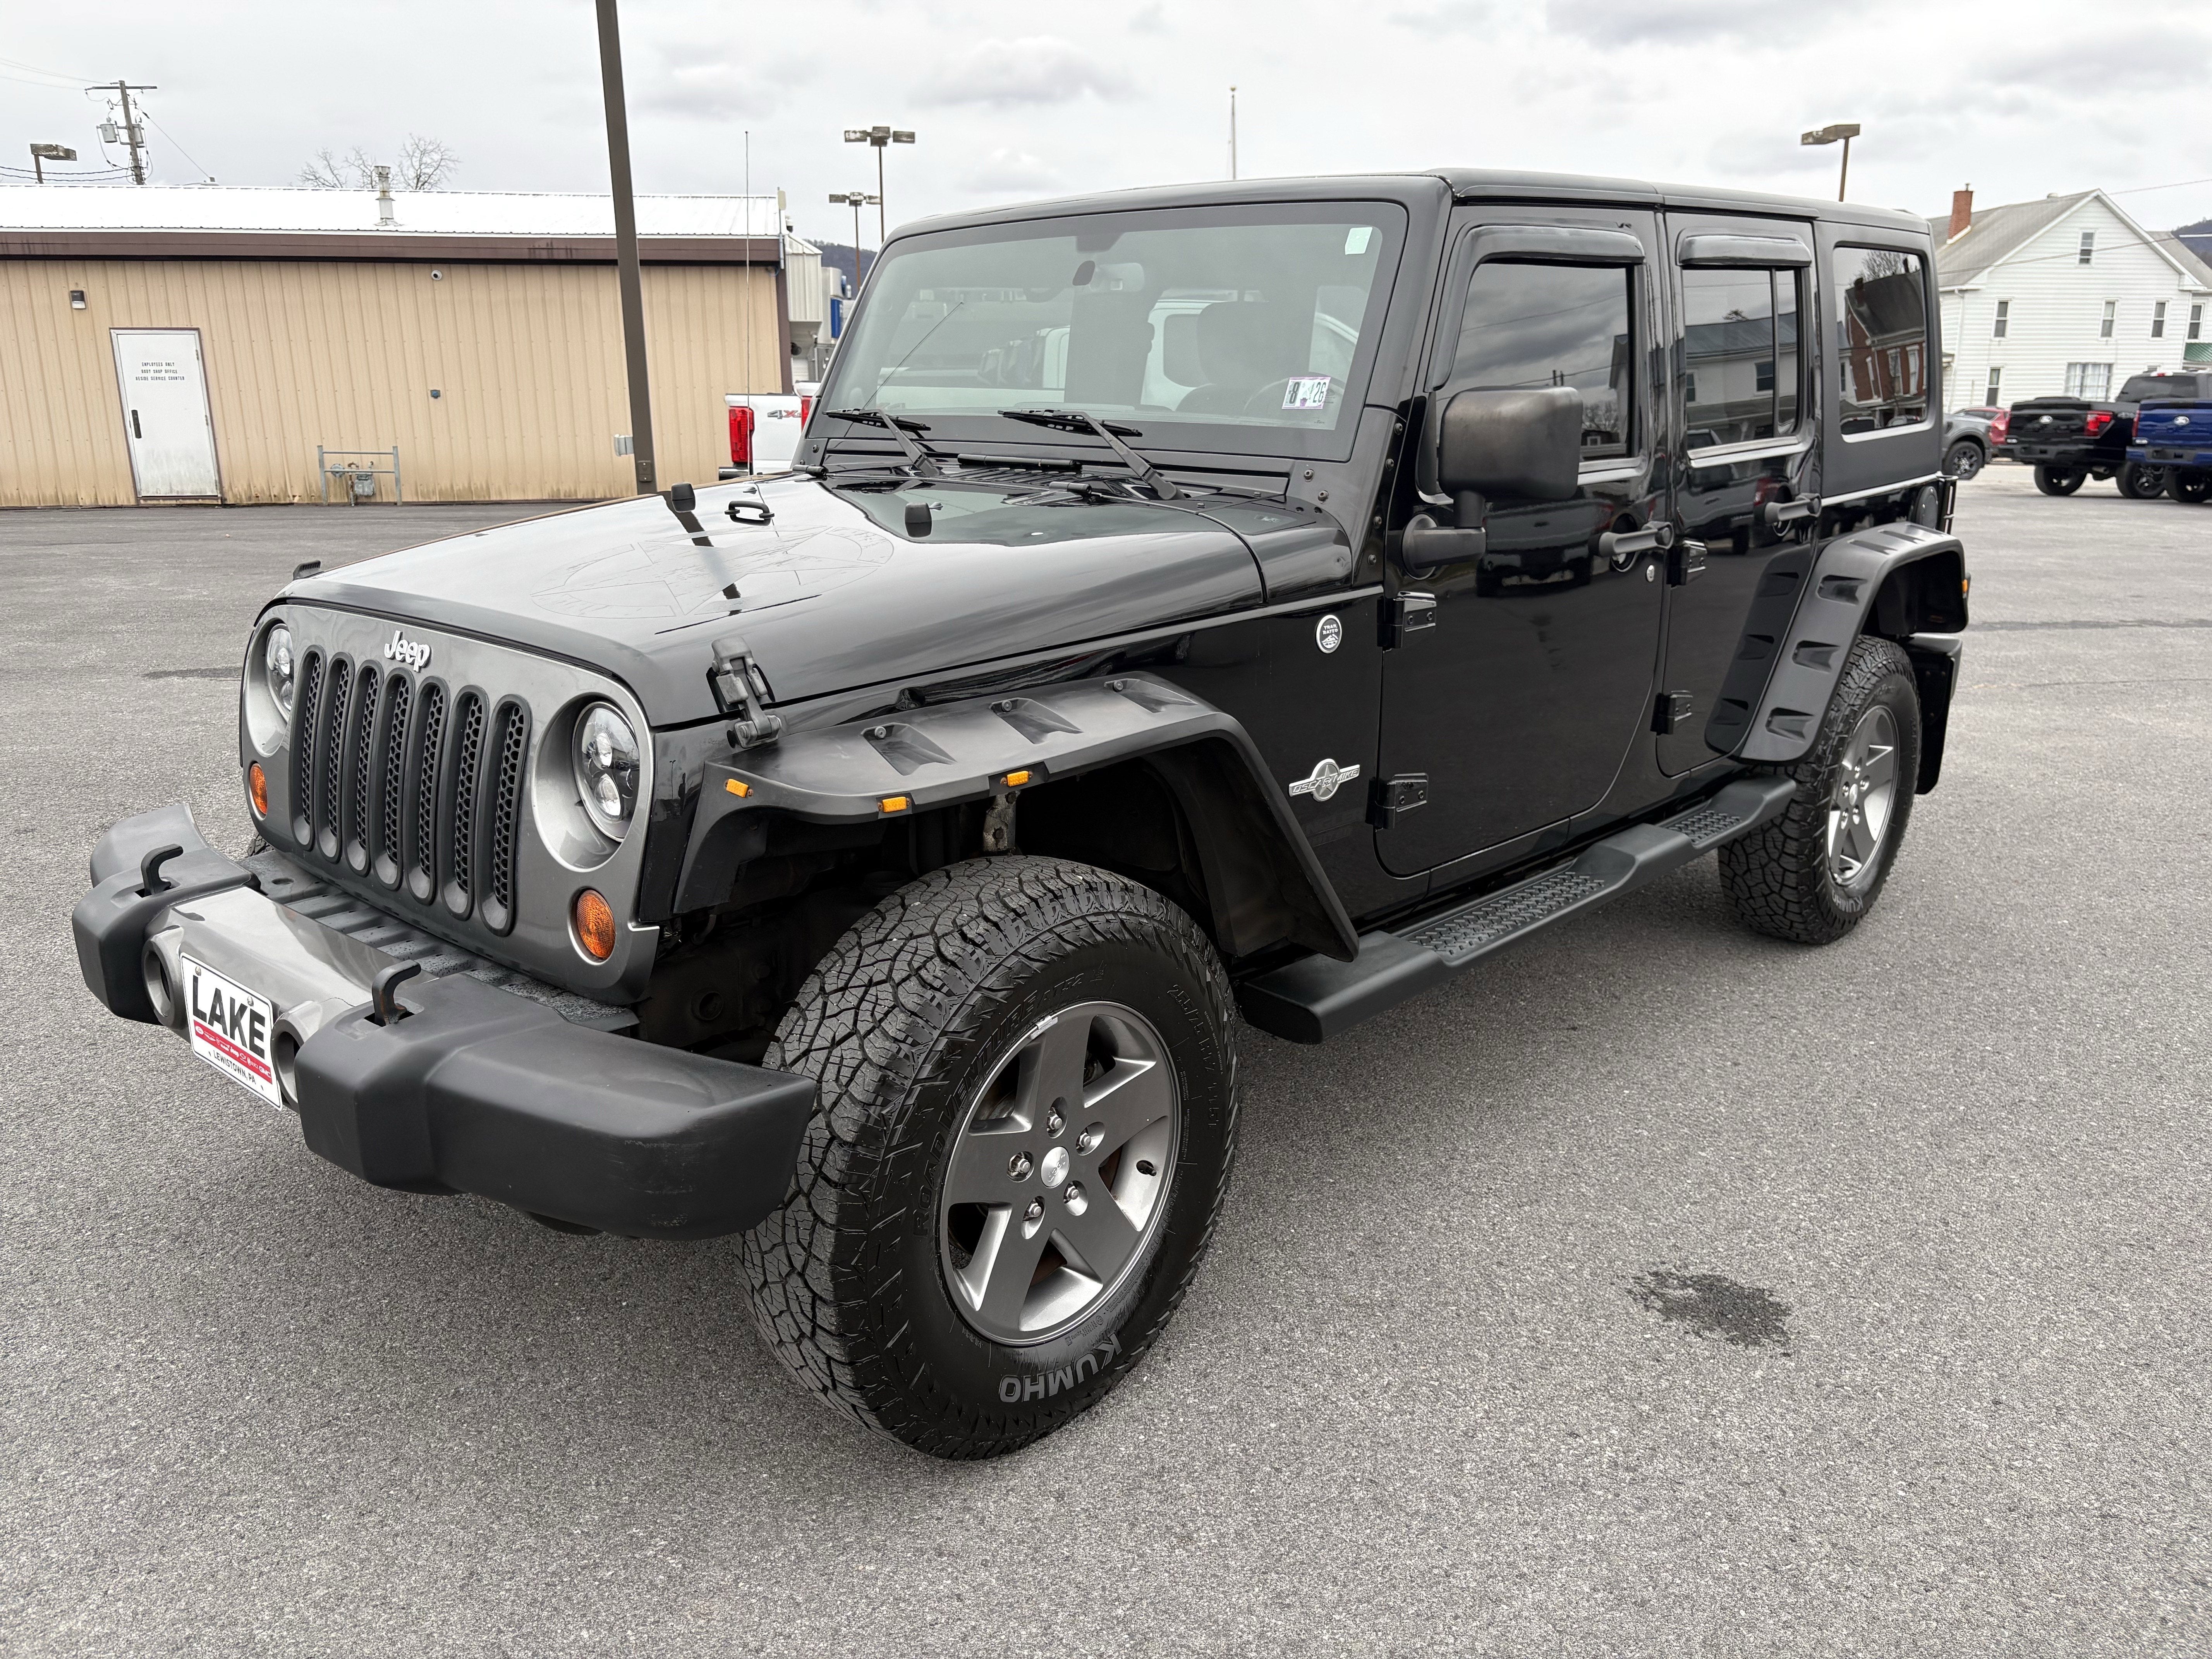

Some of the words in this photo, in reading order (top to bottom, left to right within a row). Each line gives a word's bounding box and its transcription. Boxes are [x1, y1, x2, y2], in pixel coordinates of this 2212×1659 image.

[1312, 382, 1326, 403] 26
[384, 630, 430, 672] Jeep
[1293, 777, 1331, 793] OSCAR
[1333, 769, 1358, 783] MIKE
[1832, 889, 1863, 912] KUMHO
[193, 975, 265, 1060] LAKE
[248, 1072, 256, 1085] PA
[912, 1132, 945, 1237] ROAD
[938, 990, 1038, 1130] VENTURE
[999, 1332, 1123, 1403] KUMHO
